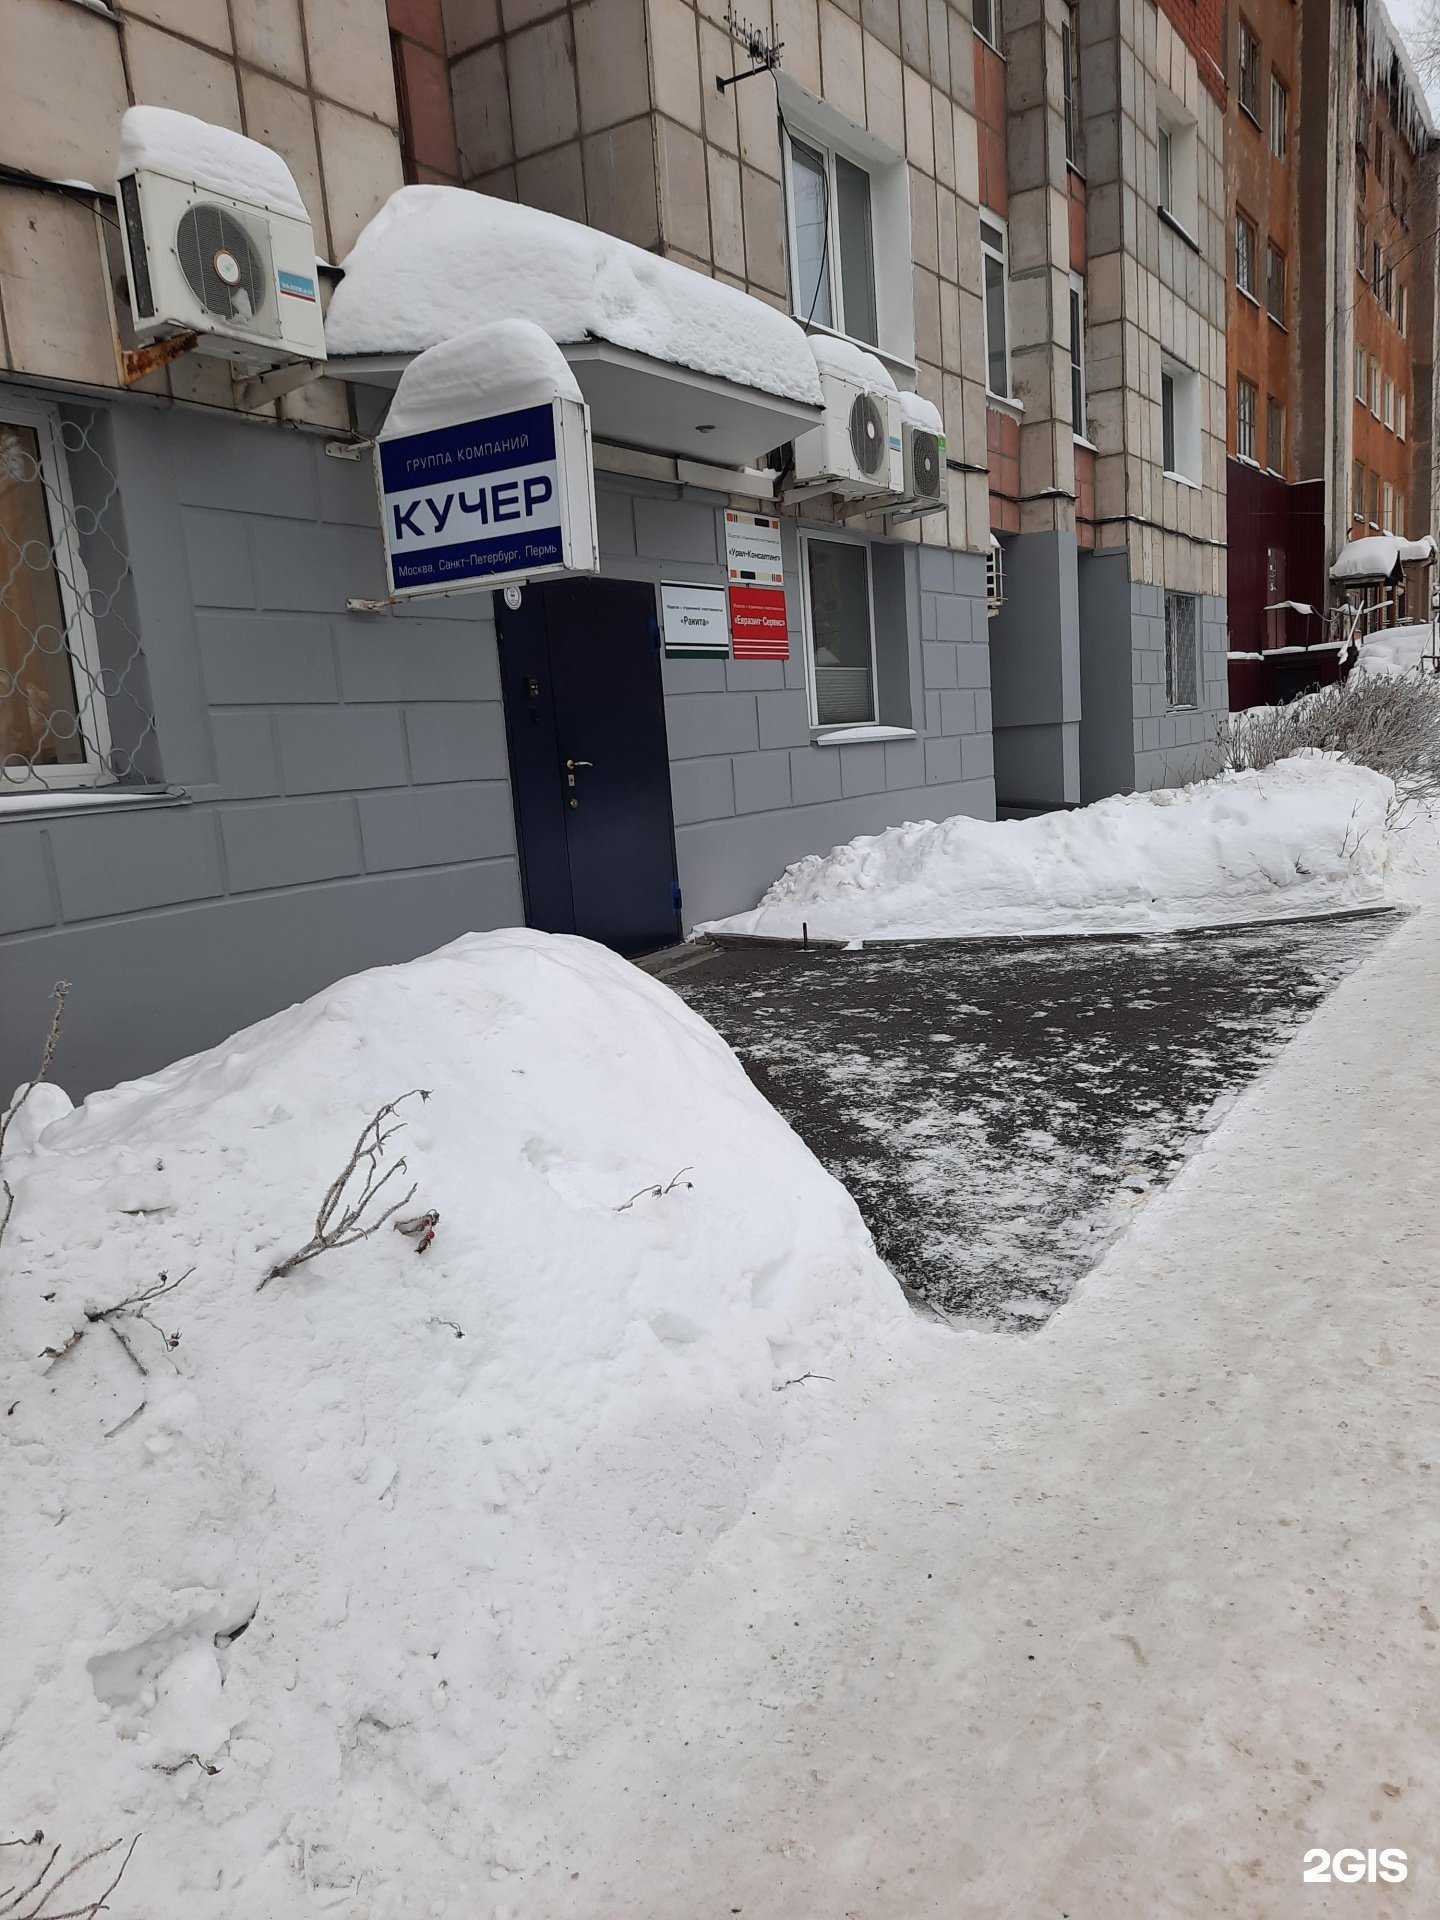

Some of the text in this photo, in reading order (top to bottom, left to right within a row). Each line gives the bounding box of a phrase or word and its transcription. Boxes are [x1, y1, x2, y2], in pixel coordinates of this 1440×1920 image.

[406, 434, 529, 472] ГРУППА КОМПАНИЙ
[393, 475, 553, 540] КУЧЕР
[399, 545, 558, 577] Москва, Санкт-Петербург, Пермь
